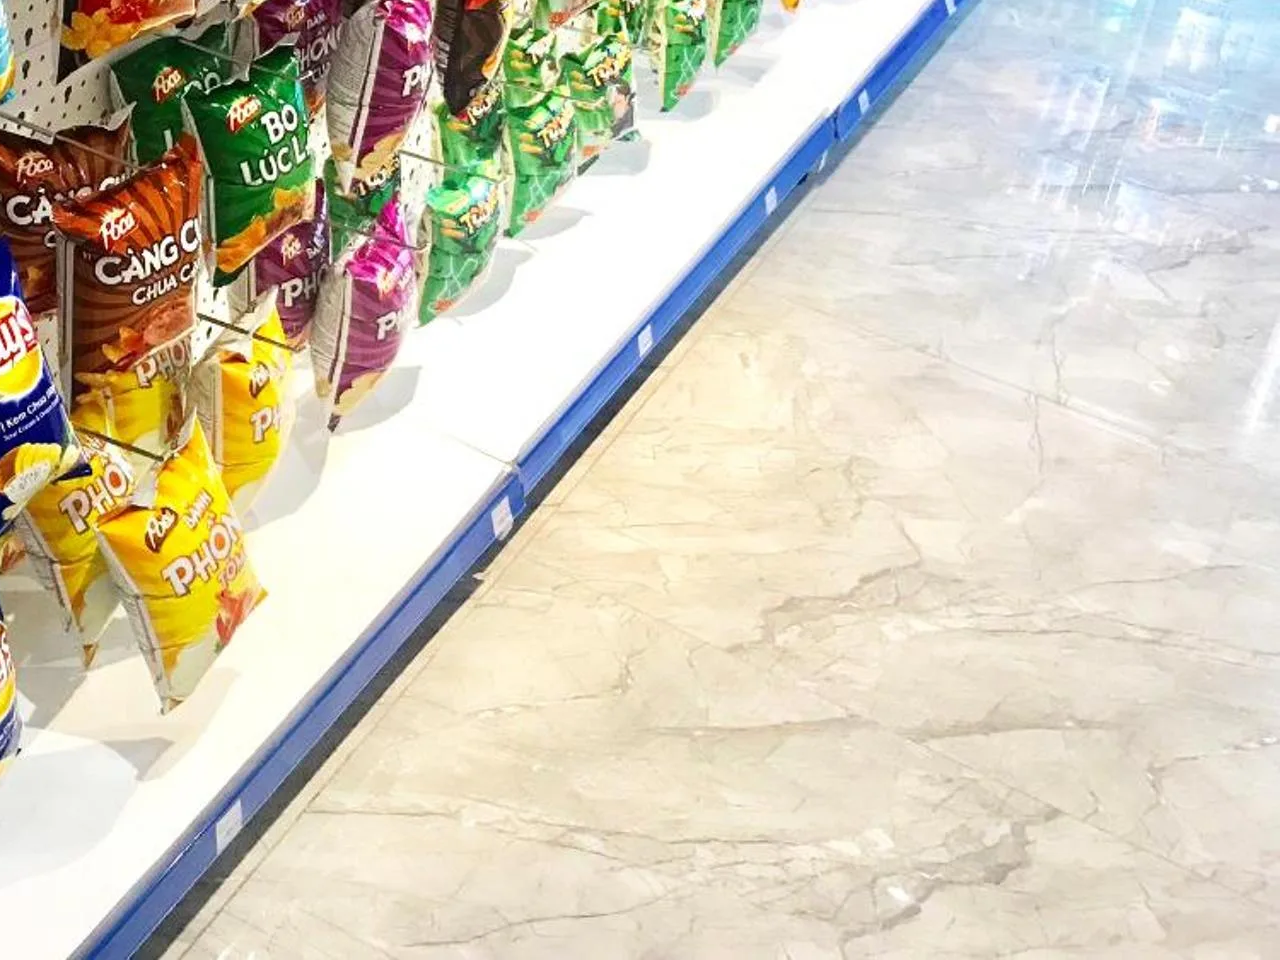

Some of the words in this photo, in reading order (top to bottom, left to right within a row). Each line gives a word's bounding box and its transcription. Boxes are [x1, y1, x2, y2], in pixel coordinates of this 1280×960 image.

[240, 148, 293, 186] LÚC
[95, 236, 178, 285] CÀNG
[132, 274, 177, 305] CHUA
